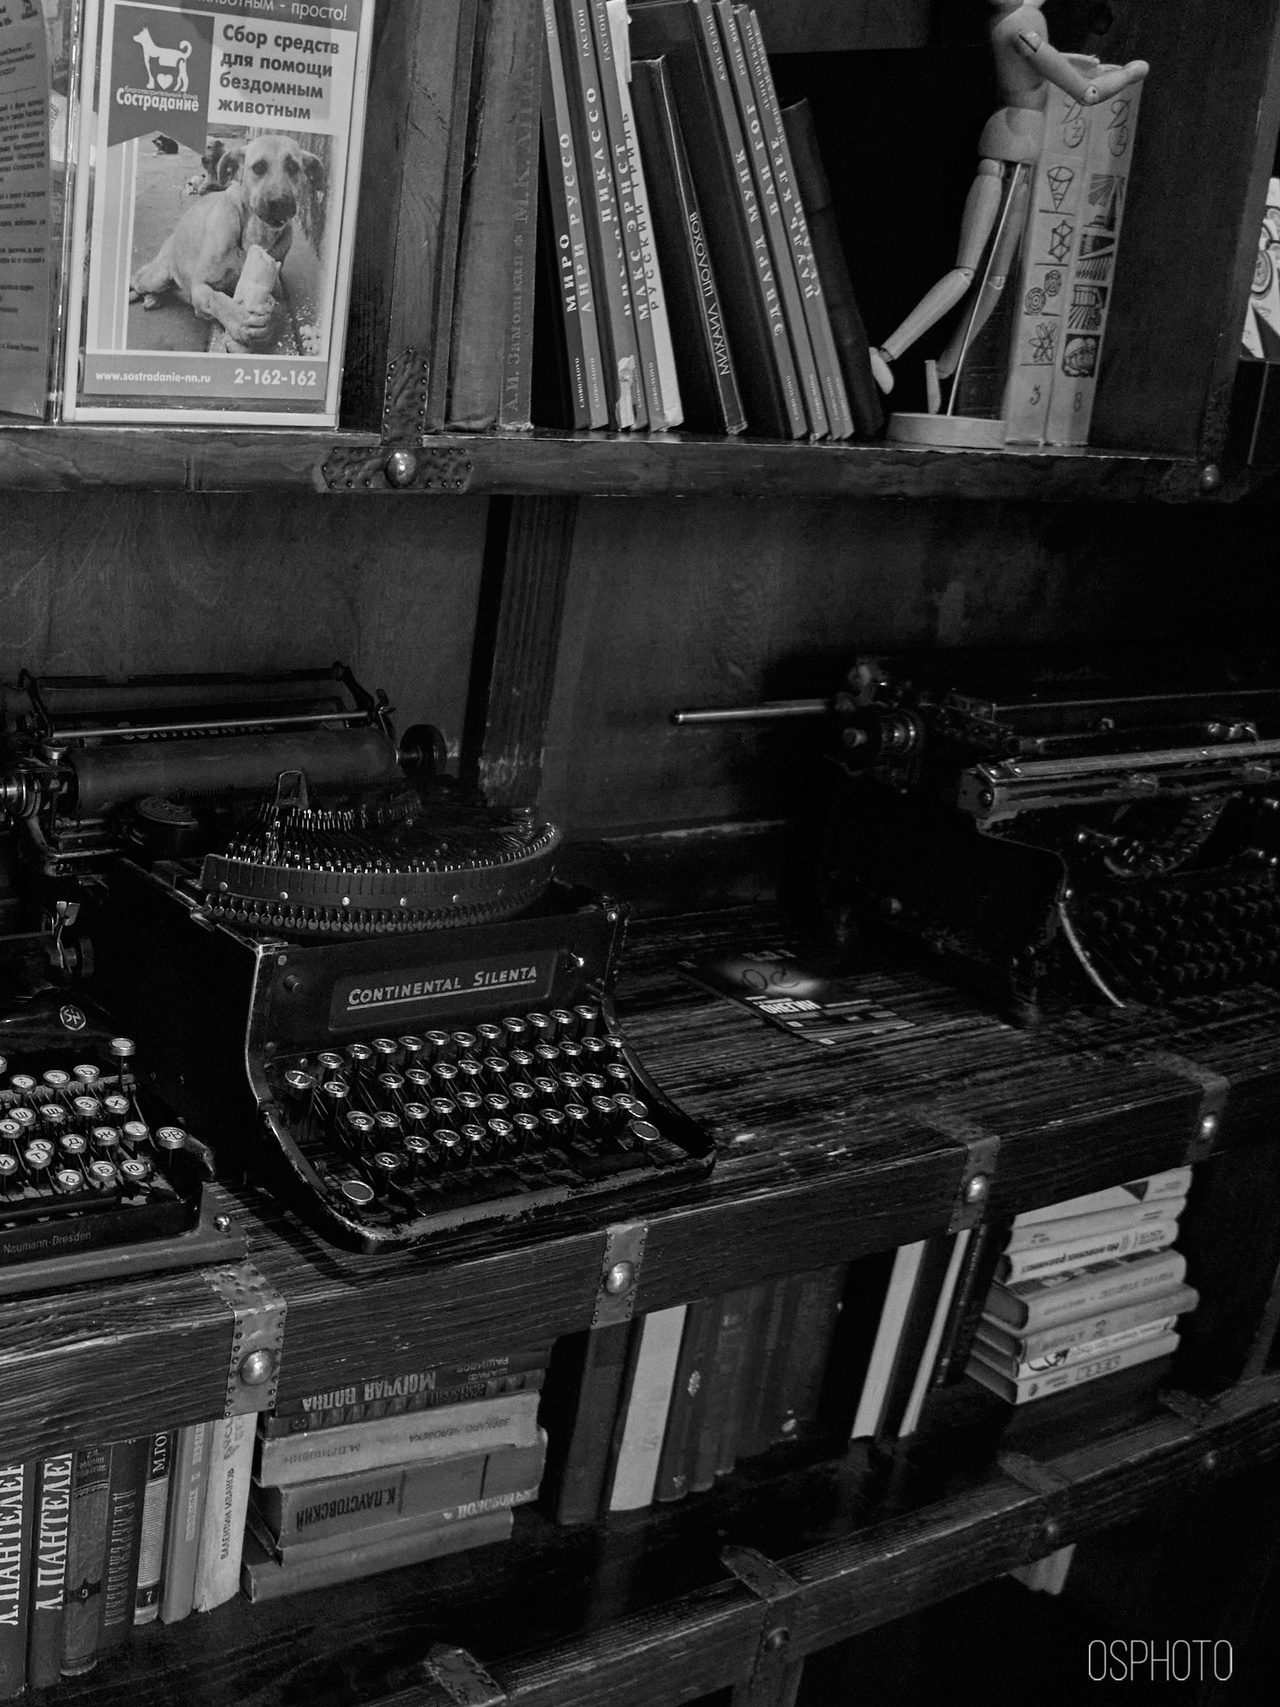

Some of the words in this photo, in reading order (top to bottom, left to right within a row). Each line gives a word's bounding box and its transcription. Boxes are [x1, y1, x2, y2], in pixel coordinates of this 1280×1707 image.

[290, 2, 348, 21] просто!
[578, 9, 590, 57] ГАСТОН
[598, 9, 611, 61] ГАСТОН
[223, 24, 268, 47] Сбор
[273, 33, 340, 54] средств
[220, 73, 323, 98] бездомным
[221, 53, 255, 71] для
[260, 58, 333, 78] помощи
[116, 87, 199, 112] Сострадание
[218, 101, 311, 120] животным
[746, 104, 765, 151] ГОГ
[587, 87, 613, 223] ПИКАССО
[770, 139, 792, 204] КЛЕЕ
[560, 133, 581, 227] РУССО
[615, 143, 638, 231] ЭРНСТ
[735, 150, 760, 223] МУНК
[760, 167, 780, 216] ВАН
[560, 233, 577, 312] МИРО
[574, 242, 592, 312] АНРИ
[689, 211, 716, 297] ШОЛОХОВ
[789, 216, 813, 299] ПАУЛЬ
[630, 249, 650, 321] МАКС
[755, 235, 785, 337] ЭДВАРД
[706, 301, 730, 376] МИХАИЛ
[95, 371, 211, 384] www.sostradanie-nn.ru
[234, 368, 317, 387] 2-162-162
[349, 976, 462, 1005] CONTINENTAL
[474, 963, 538, 988] SILENTA
[5, 1230, 92, 1253] Naumann-Dresden
[302, 1387, 356, 1411] ВОЛНА
[364, 1370, 437, 1401] МОГУЧАЯ
[224, 1468, 235, 1511] ИВАНОВ
[296, 1487, 396, 1532] К.ПАУСТОВСКИЙ
[220, 1511, 231, 1560] ВАЛЕНТИН
